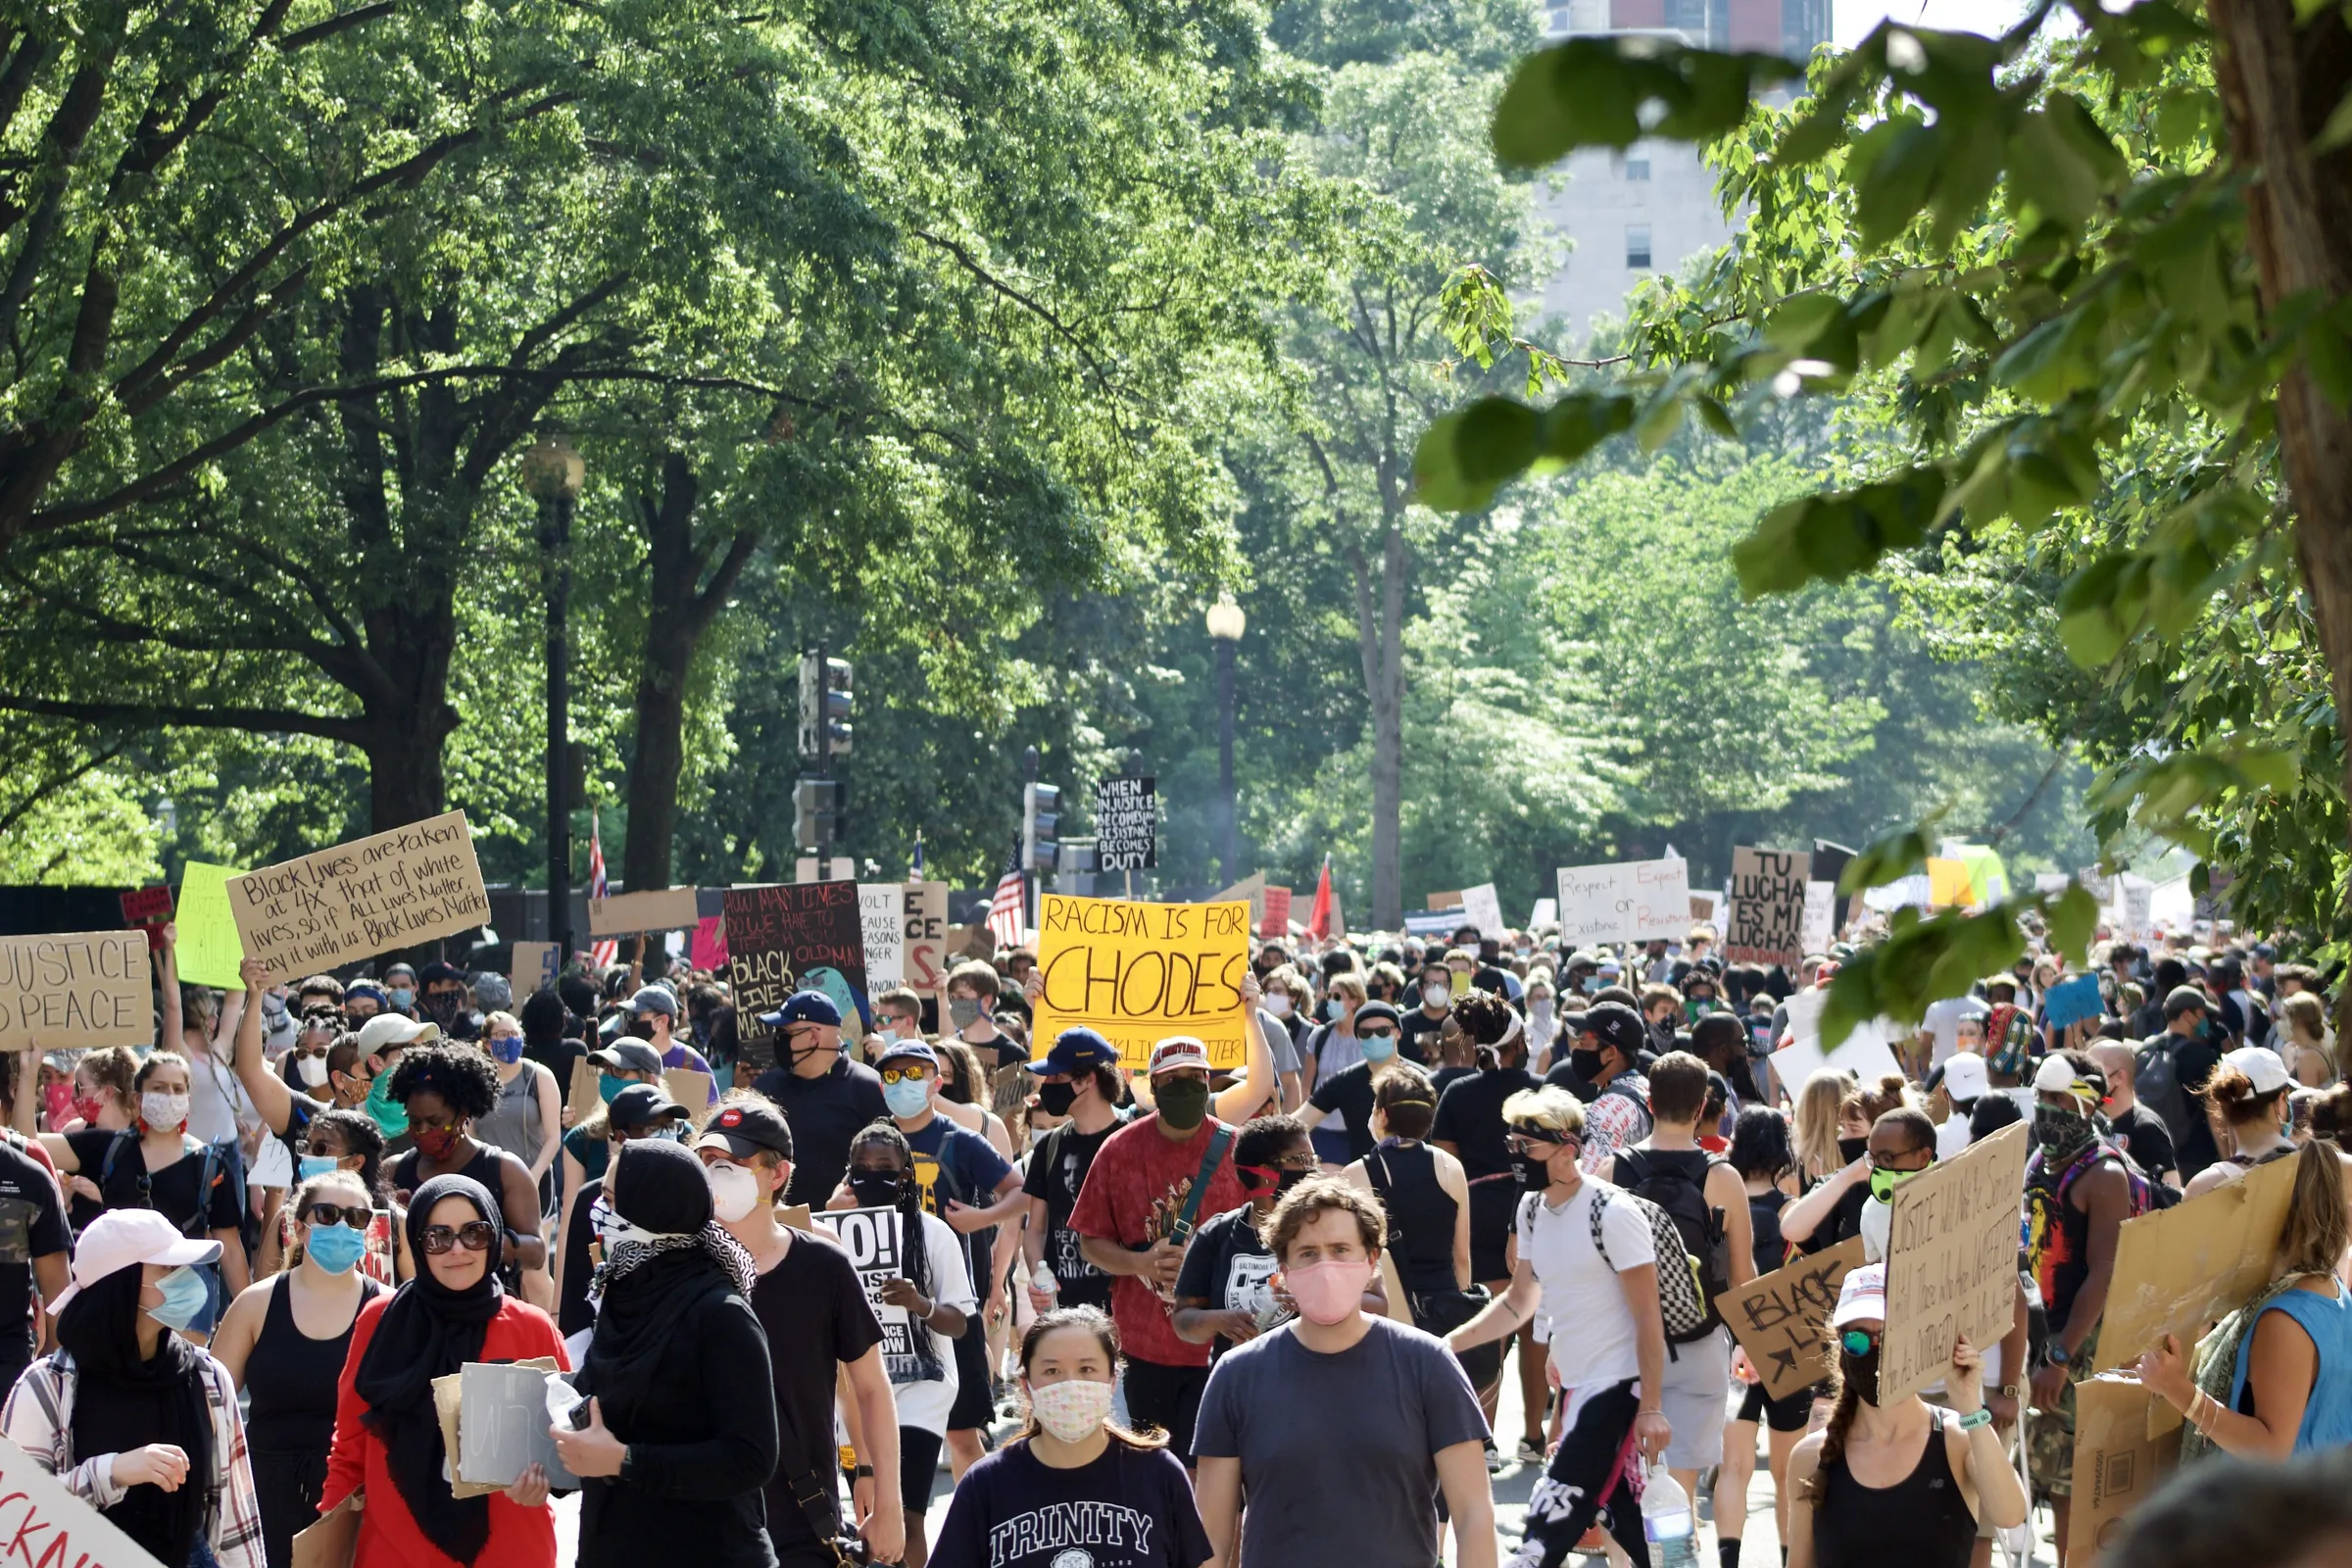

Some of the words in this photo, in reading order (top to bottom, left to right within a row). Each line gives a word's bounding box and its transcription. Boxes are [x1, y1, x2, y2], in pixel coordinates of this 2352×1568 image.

[1098, 779, 1142, 797] WHEN
[1098, 795, 1154, 811] INJUSTICE
[1097, 810, 1143, 826] BECOMES
[1097, 824, 1154, 840] RESISTANCE
[1100, 838, 1151, 853] BECOMES
[242, 865, 308, 906] Black
[363, 840, 395, 865] are
[394, 824, 460, 854] taken
[1102, 852, 1147, 872] DUTY
[1753, 851, 1792, 877] TU
[265, 896, 288, 919] at
[337, 873, 383, 904] that
[388, 860, 408, 888] of
[413, 854, 465, 880] white
[1560, 873, 1617, 898] Respect
[1636, 862, 1684, 891] Expect
[1732, 874, 1805, 904] LUCHA
[758, 885, 793, 911] MANY
[797, 882, 854, 907] TIMES
[1615, 899, 1635, 913] or
[298, 915, 321, 937] so
[324, 906, 340, 930] if
[350, 899, 381, 921] ALL
[727, 915, 745, 938] DO
[746, 913, 775, 935] WE
[782, 910, 808, 931] HAVE
[812, 908, 835, 928] TO
[1045, 898, 1149, 939] RACISM
[1159, 907, 1191, 940] IS
[1203, 906, 1245, 939] FOR
[1737, 901, 1765, 926] ES
[1773, 905, 1801, 932] MI
[290, 948, 303, 965] it
[306, 934, 340, 960] with
[363, 916, 401, 948] Black
[730, 932, 796, 953] TEACH
[802, 929, 837, 944] YOU
[1727, 924, 1798, 952] LUCHA
[730, 950, 795, 986] BLACK
[795, 945, 831, 963] OLD
[1043, 945, 1245, 1018] CHODES
[19, 989, 137, 1031] PEACE
[1741, 1260, 1842, 1333] BLACK
[990, 1501, 1152, 1568] TRINITY
